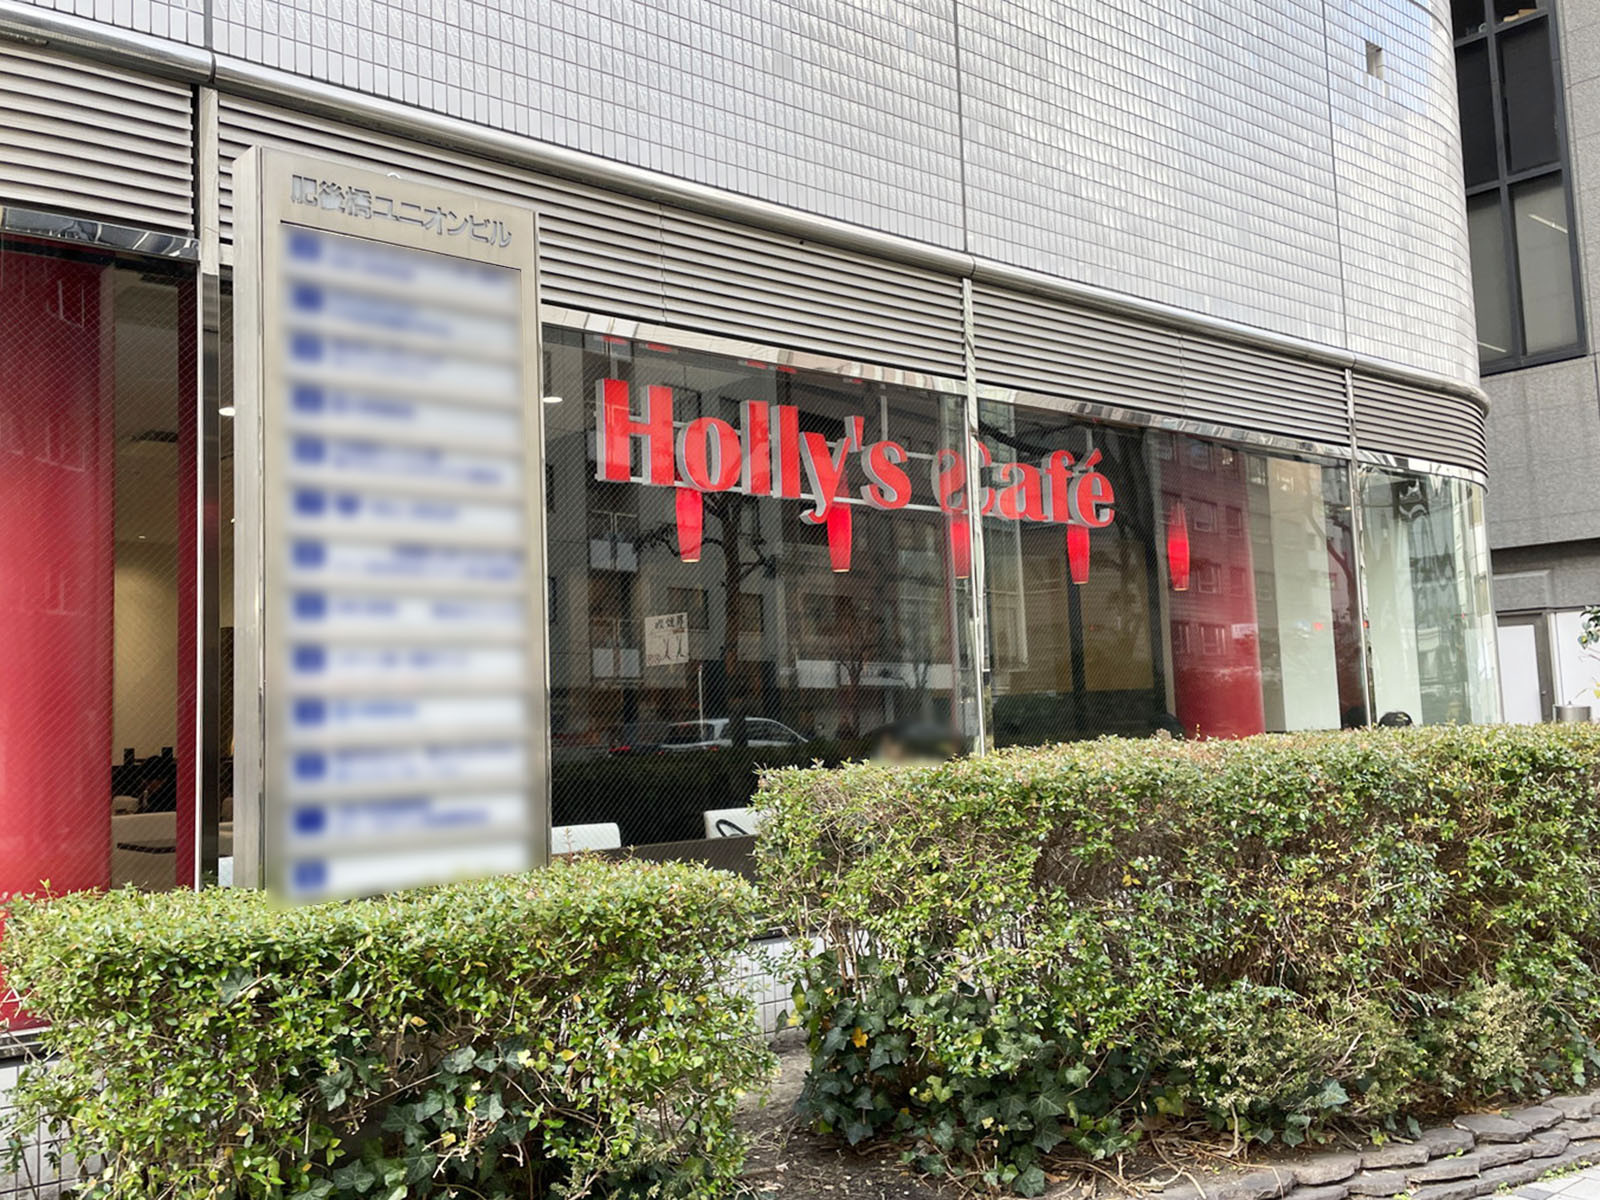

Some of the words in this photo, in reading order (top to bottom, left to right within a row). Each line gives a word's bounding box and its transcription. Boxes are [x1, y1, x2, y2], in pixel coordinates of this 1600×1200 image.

[290, 174, 512, 248] 肥後橋ユニオンビル
[595, 378, 912, 525] Holly's
[930, 441, 1115, 529] Café
